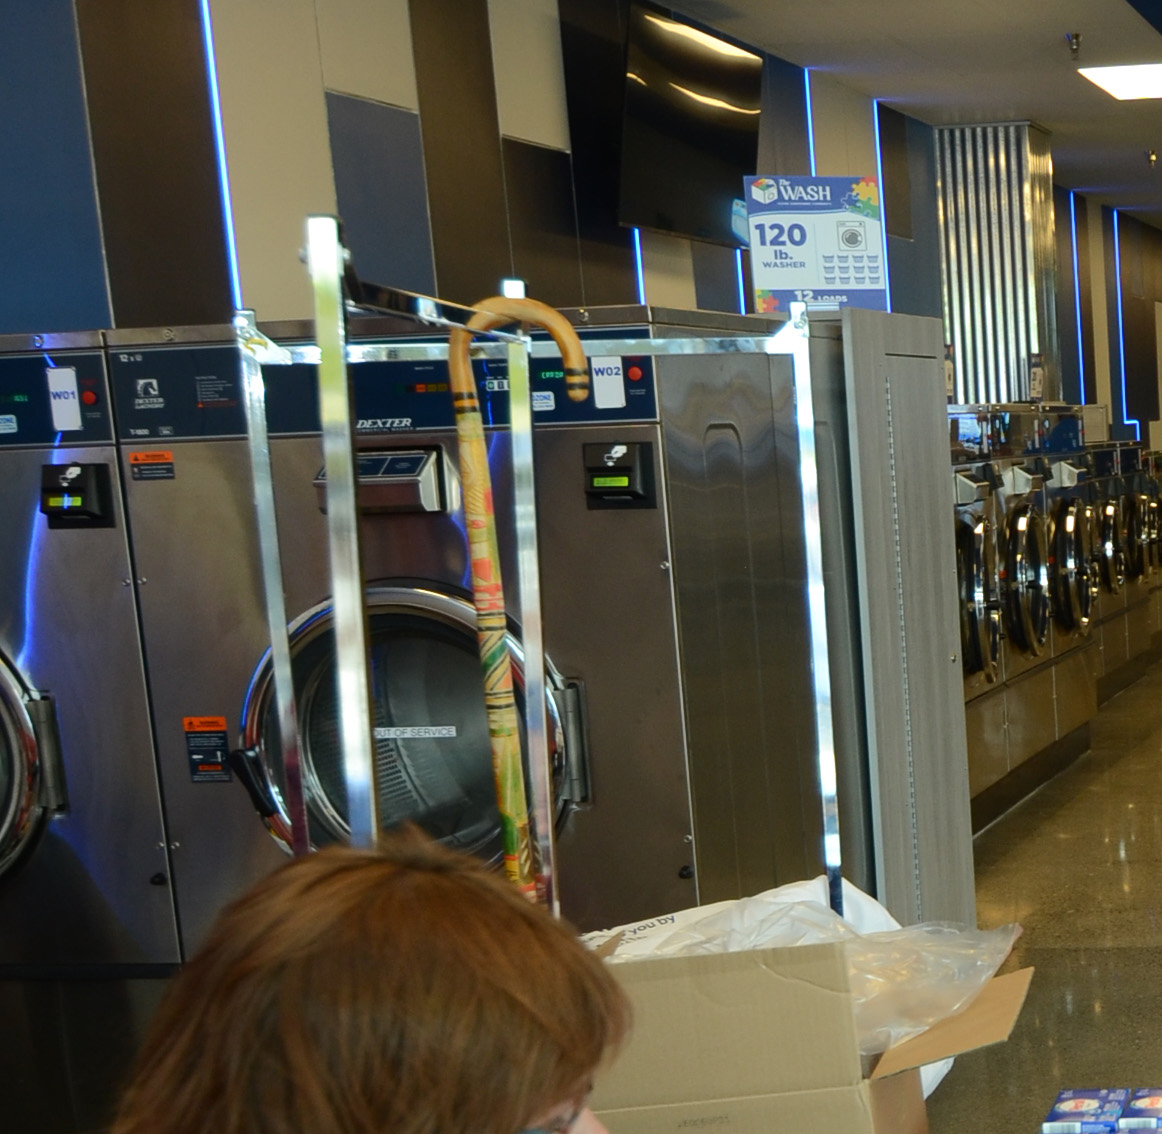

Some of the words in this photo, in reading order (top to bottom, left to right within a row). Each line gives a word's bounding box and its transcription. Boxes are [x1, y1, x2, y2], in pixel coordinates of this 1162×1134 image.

[779, 186, 831, 201] WASH
[754, 223, 807, 247] 120
[774, 249, 793, 260] lb.
[762, 261, 806, 269] WASHER
[794, 290, 815, 301] 12
[818, 294, 848, 302] LOADS
[594, 366, 622, 377] W02
[51, 391, 76, 401] W01
[356, 418, 412, 429] DEXTER
[394, 728, 408, 736] OF
[410, 727, 454, 737] SERVICE
[627, 921, 656, 935] you
[656, 915, 675, 925] by
